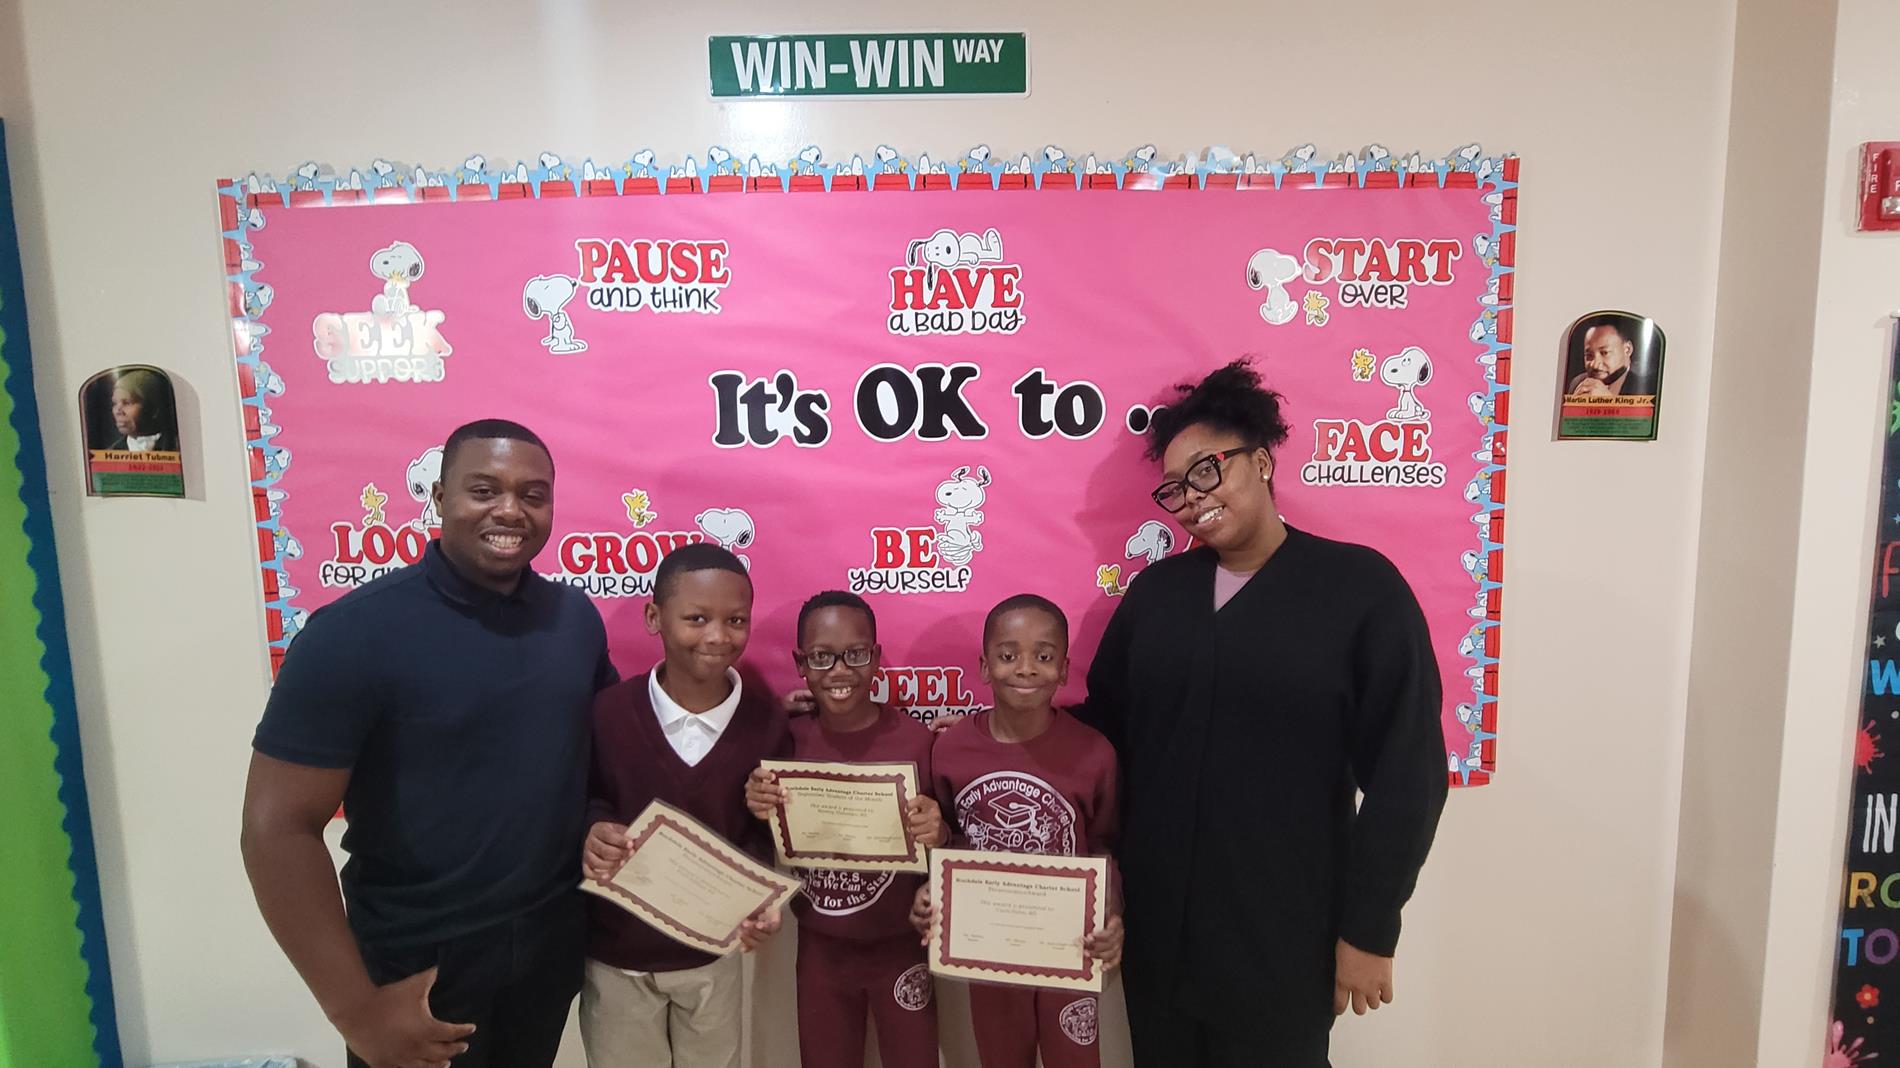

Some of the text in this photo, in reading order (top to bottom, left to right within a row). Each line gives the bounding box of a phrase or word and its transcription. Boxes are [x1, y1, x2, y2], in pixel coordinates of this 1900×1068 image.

[731, 39, 1004, 89] WIN-WIN WAY
[1870, 153, 1879, 193] FIRE
[577, 241, 729, 284] PAUSE
[1304, 240, 1461, 282] START
[890, 267, 1022, 310] HAVE
[314, 313, 451, 357] SEEK
[712, 372, 829, 445] It's
[856, 366, 986, 439] OK
[1014, 370, 1102, 439] to
[1615, 397, 1634, 405] King
[105, 453, 176, 461] Harriet Tubman
[1314, 421, 1429, 462] FACE
[873, 529, 937, 568] BE
[961, 788, 982, 809] Early
[983, 779, 1041, 798] Advantage
[824, 896, 843, 907] for
[847, 894, 867, 906] the
